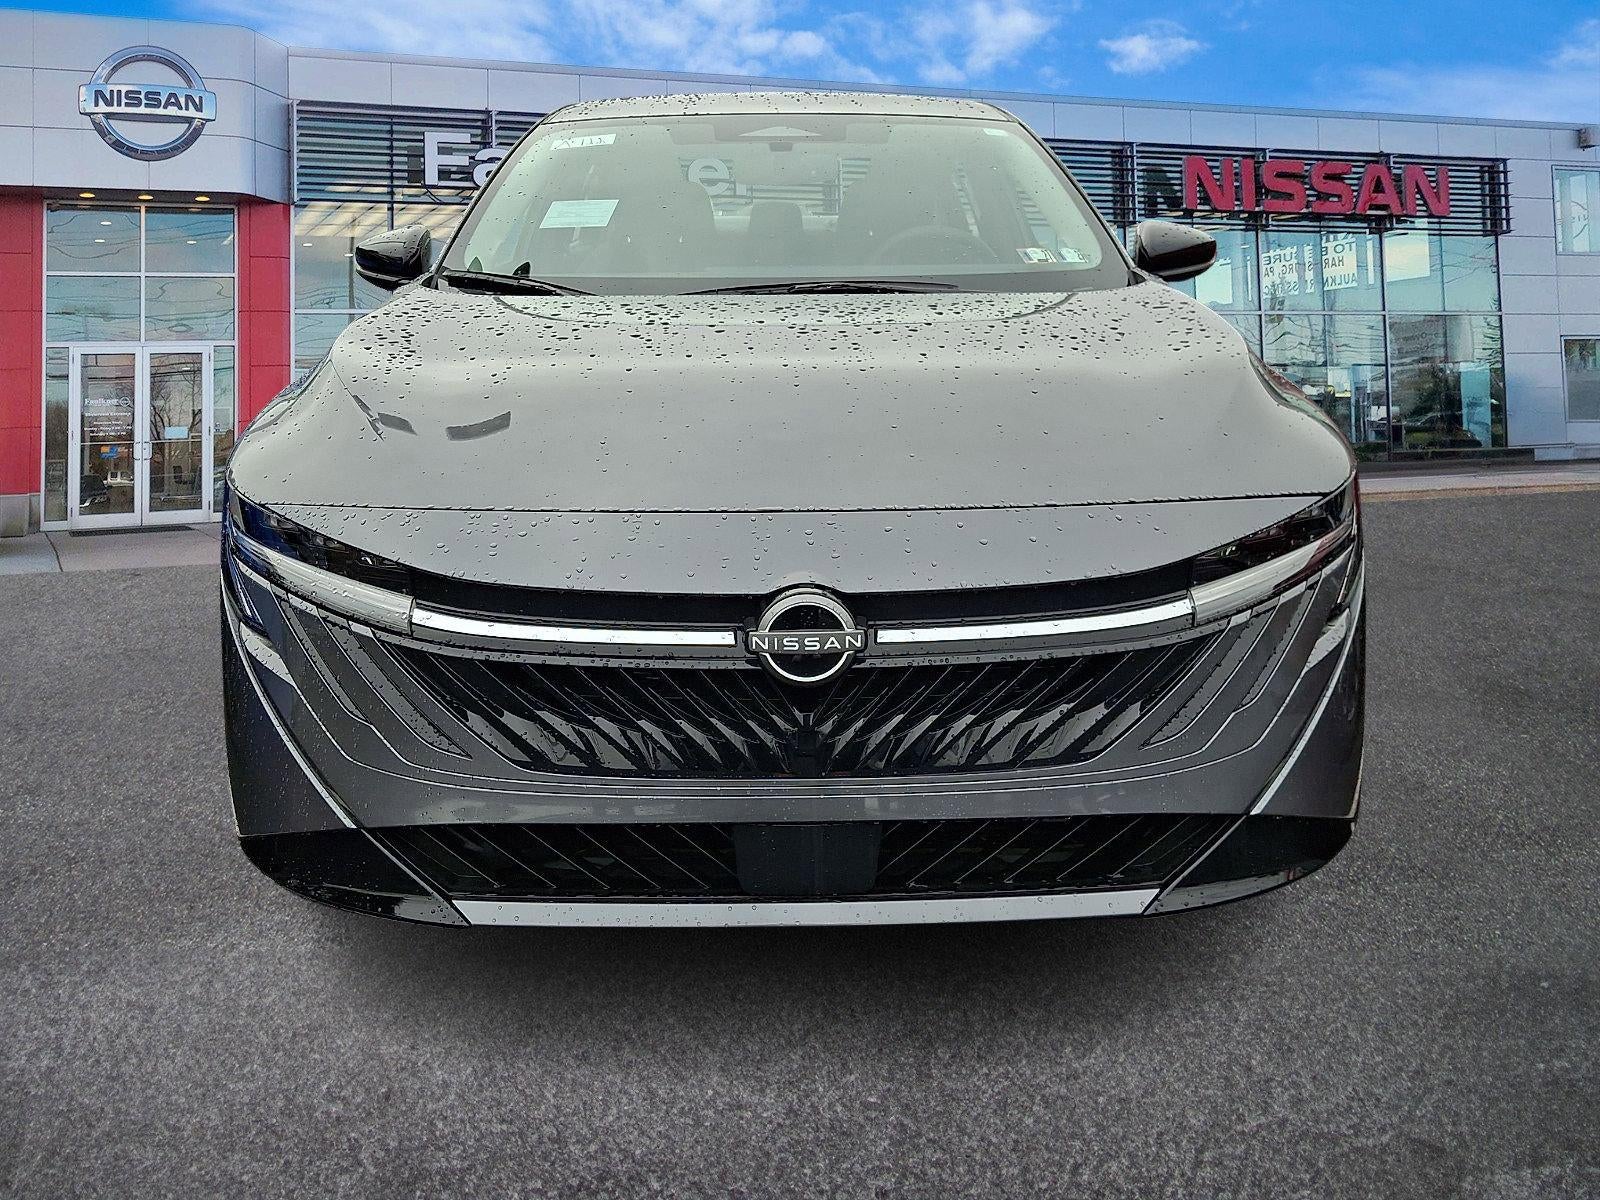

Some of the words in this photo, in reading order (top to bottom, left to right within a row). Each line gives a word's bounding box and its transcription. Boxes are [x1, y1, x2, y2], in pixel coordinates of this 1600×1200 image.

[93, 89, 204, 114] NISSAN
[1182, 155, 1451, 217] NISSAN
[752, 634, 862, 651] NISSAN
